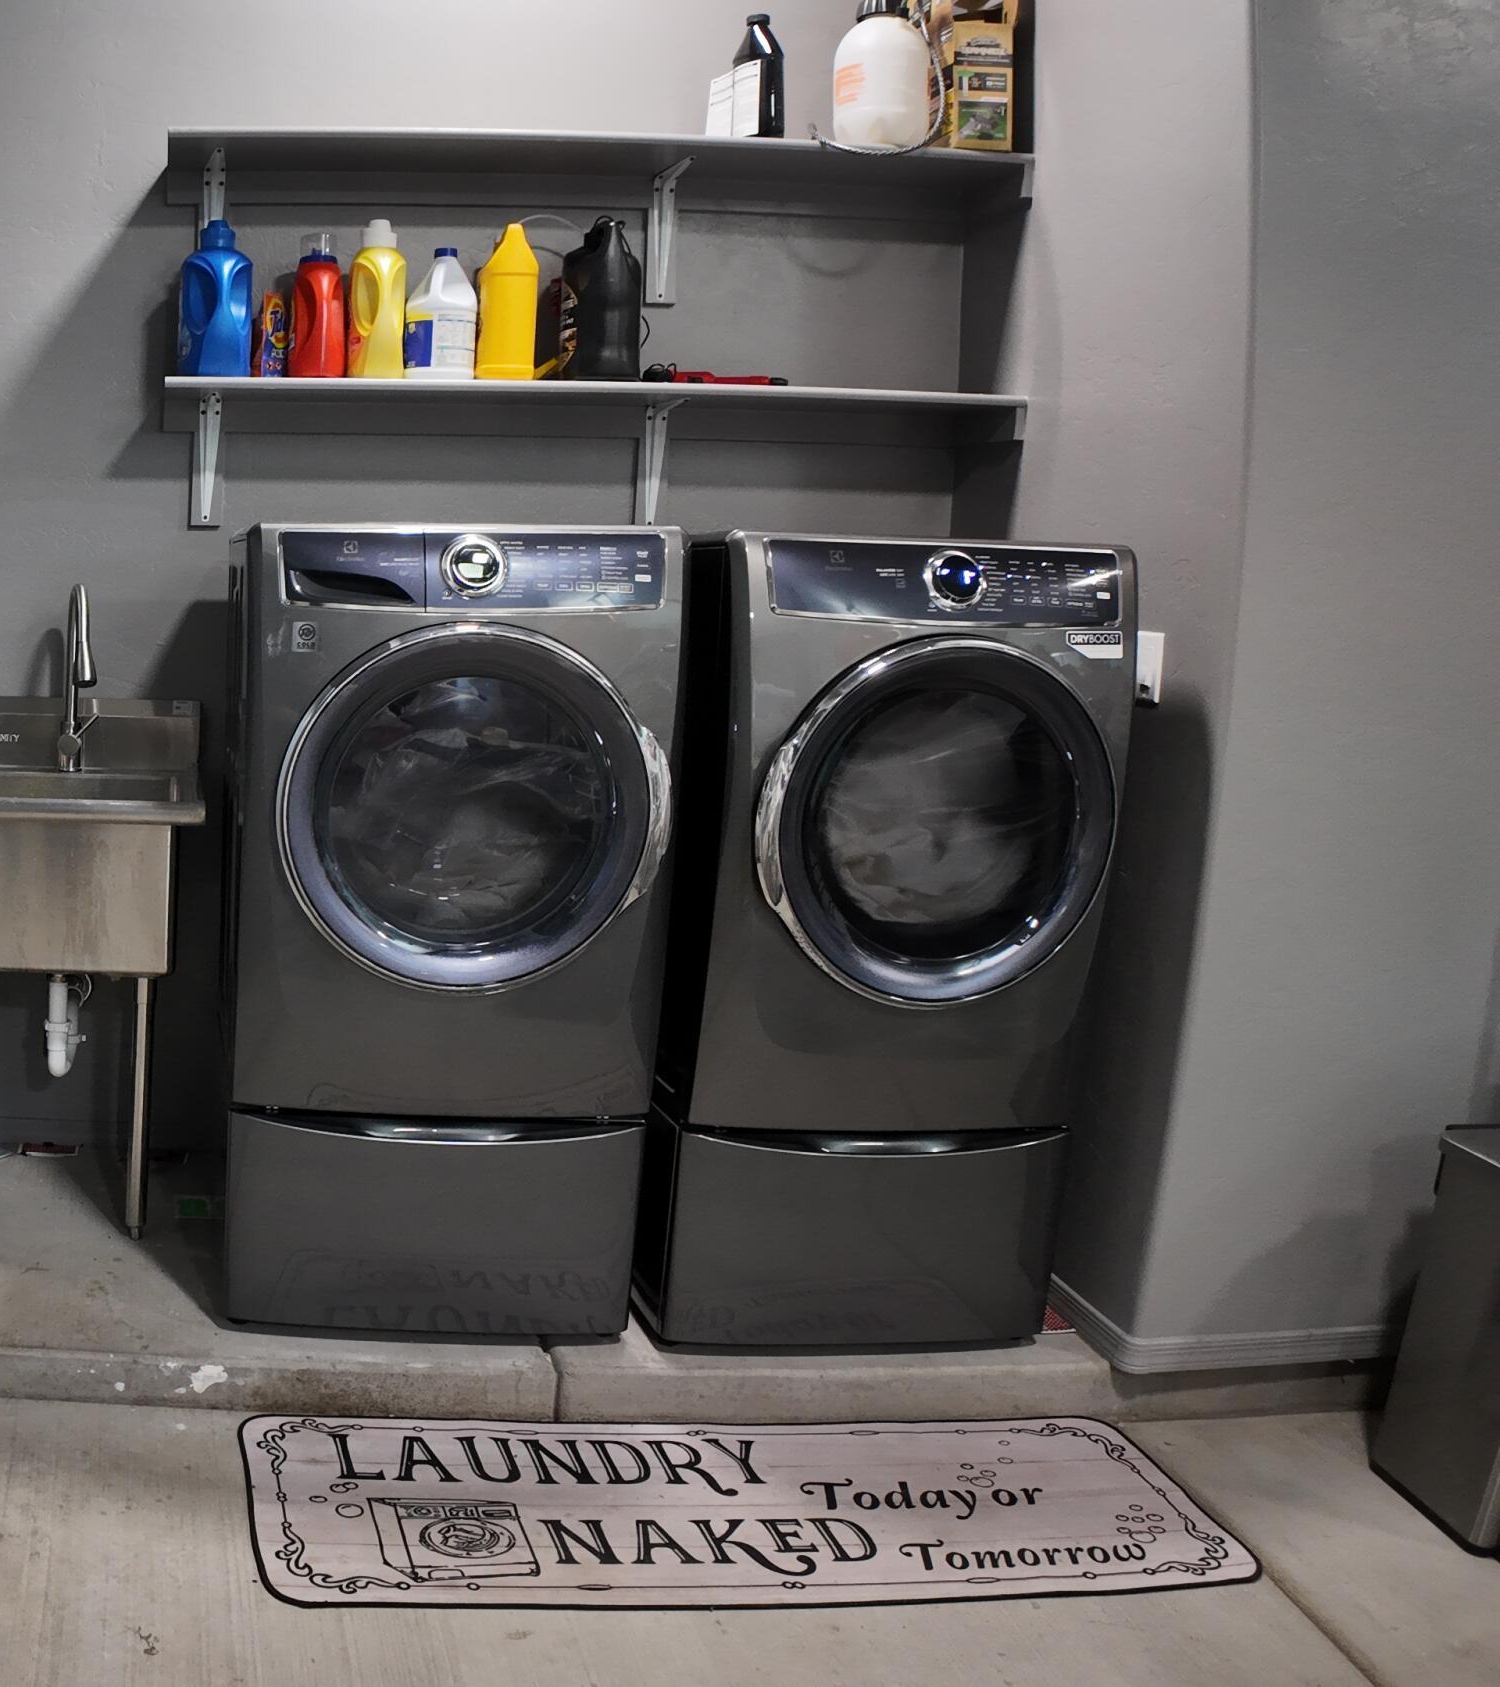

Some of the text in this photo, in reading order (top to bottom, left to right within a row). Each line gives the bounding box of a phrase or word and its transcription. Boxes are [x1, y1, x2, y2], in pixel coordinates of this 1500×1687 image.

[1070, 634, 1119, 644] DRYBOOST
[327, 1434, 767, 1496] LAUNDRY
[800, 1478, 1043, 1520] Today or
[538, 1518, 878, 1577] NAKED
[899, 1539, 1146, 1571] Tomorrow
